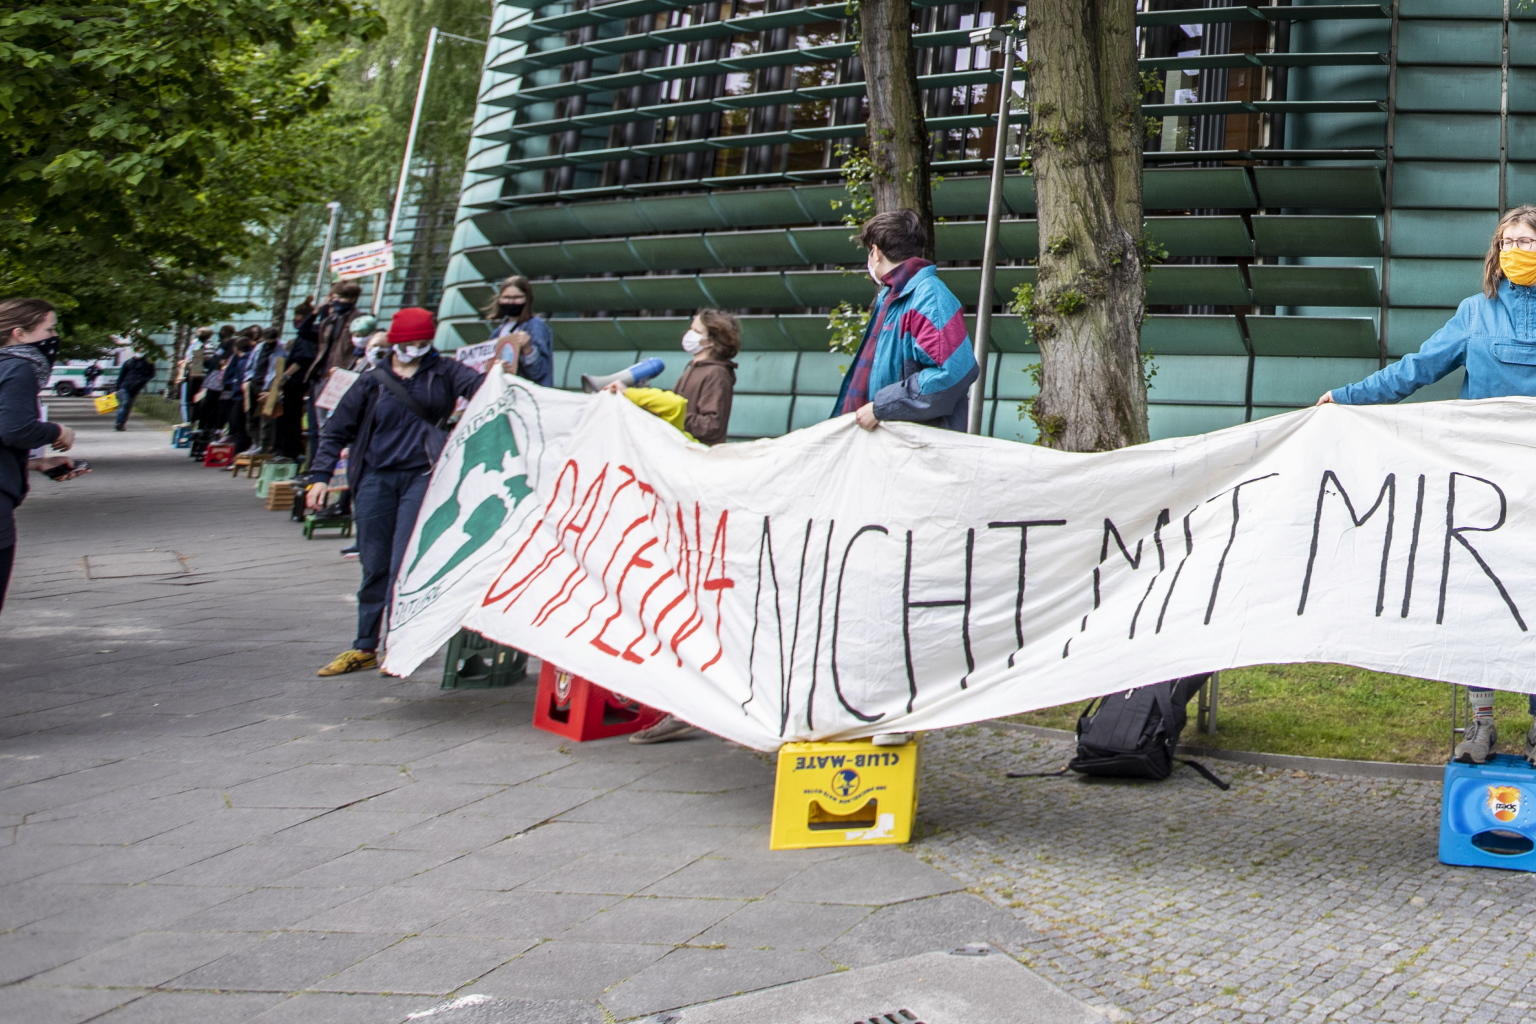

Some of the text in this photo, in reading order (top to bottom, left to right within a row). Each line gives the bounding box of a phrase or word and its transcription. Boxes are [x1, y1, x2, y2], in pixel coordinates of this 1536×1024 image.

[742, 516, 1067, 737] NICHT
[1062, 472, 1280, 659] MIT
[1297, 470, 1528, 631] MIR
[795, 752, 900, 771] CLUB-MATE
